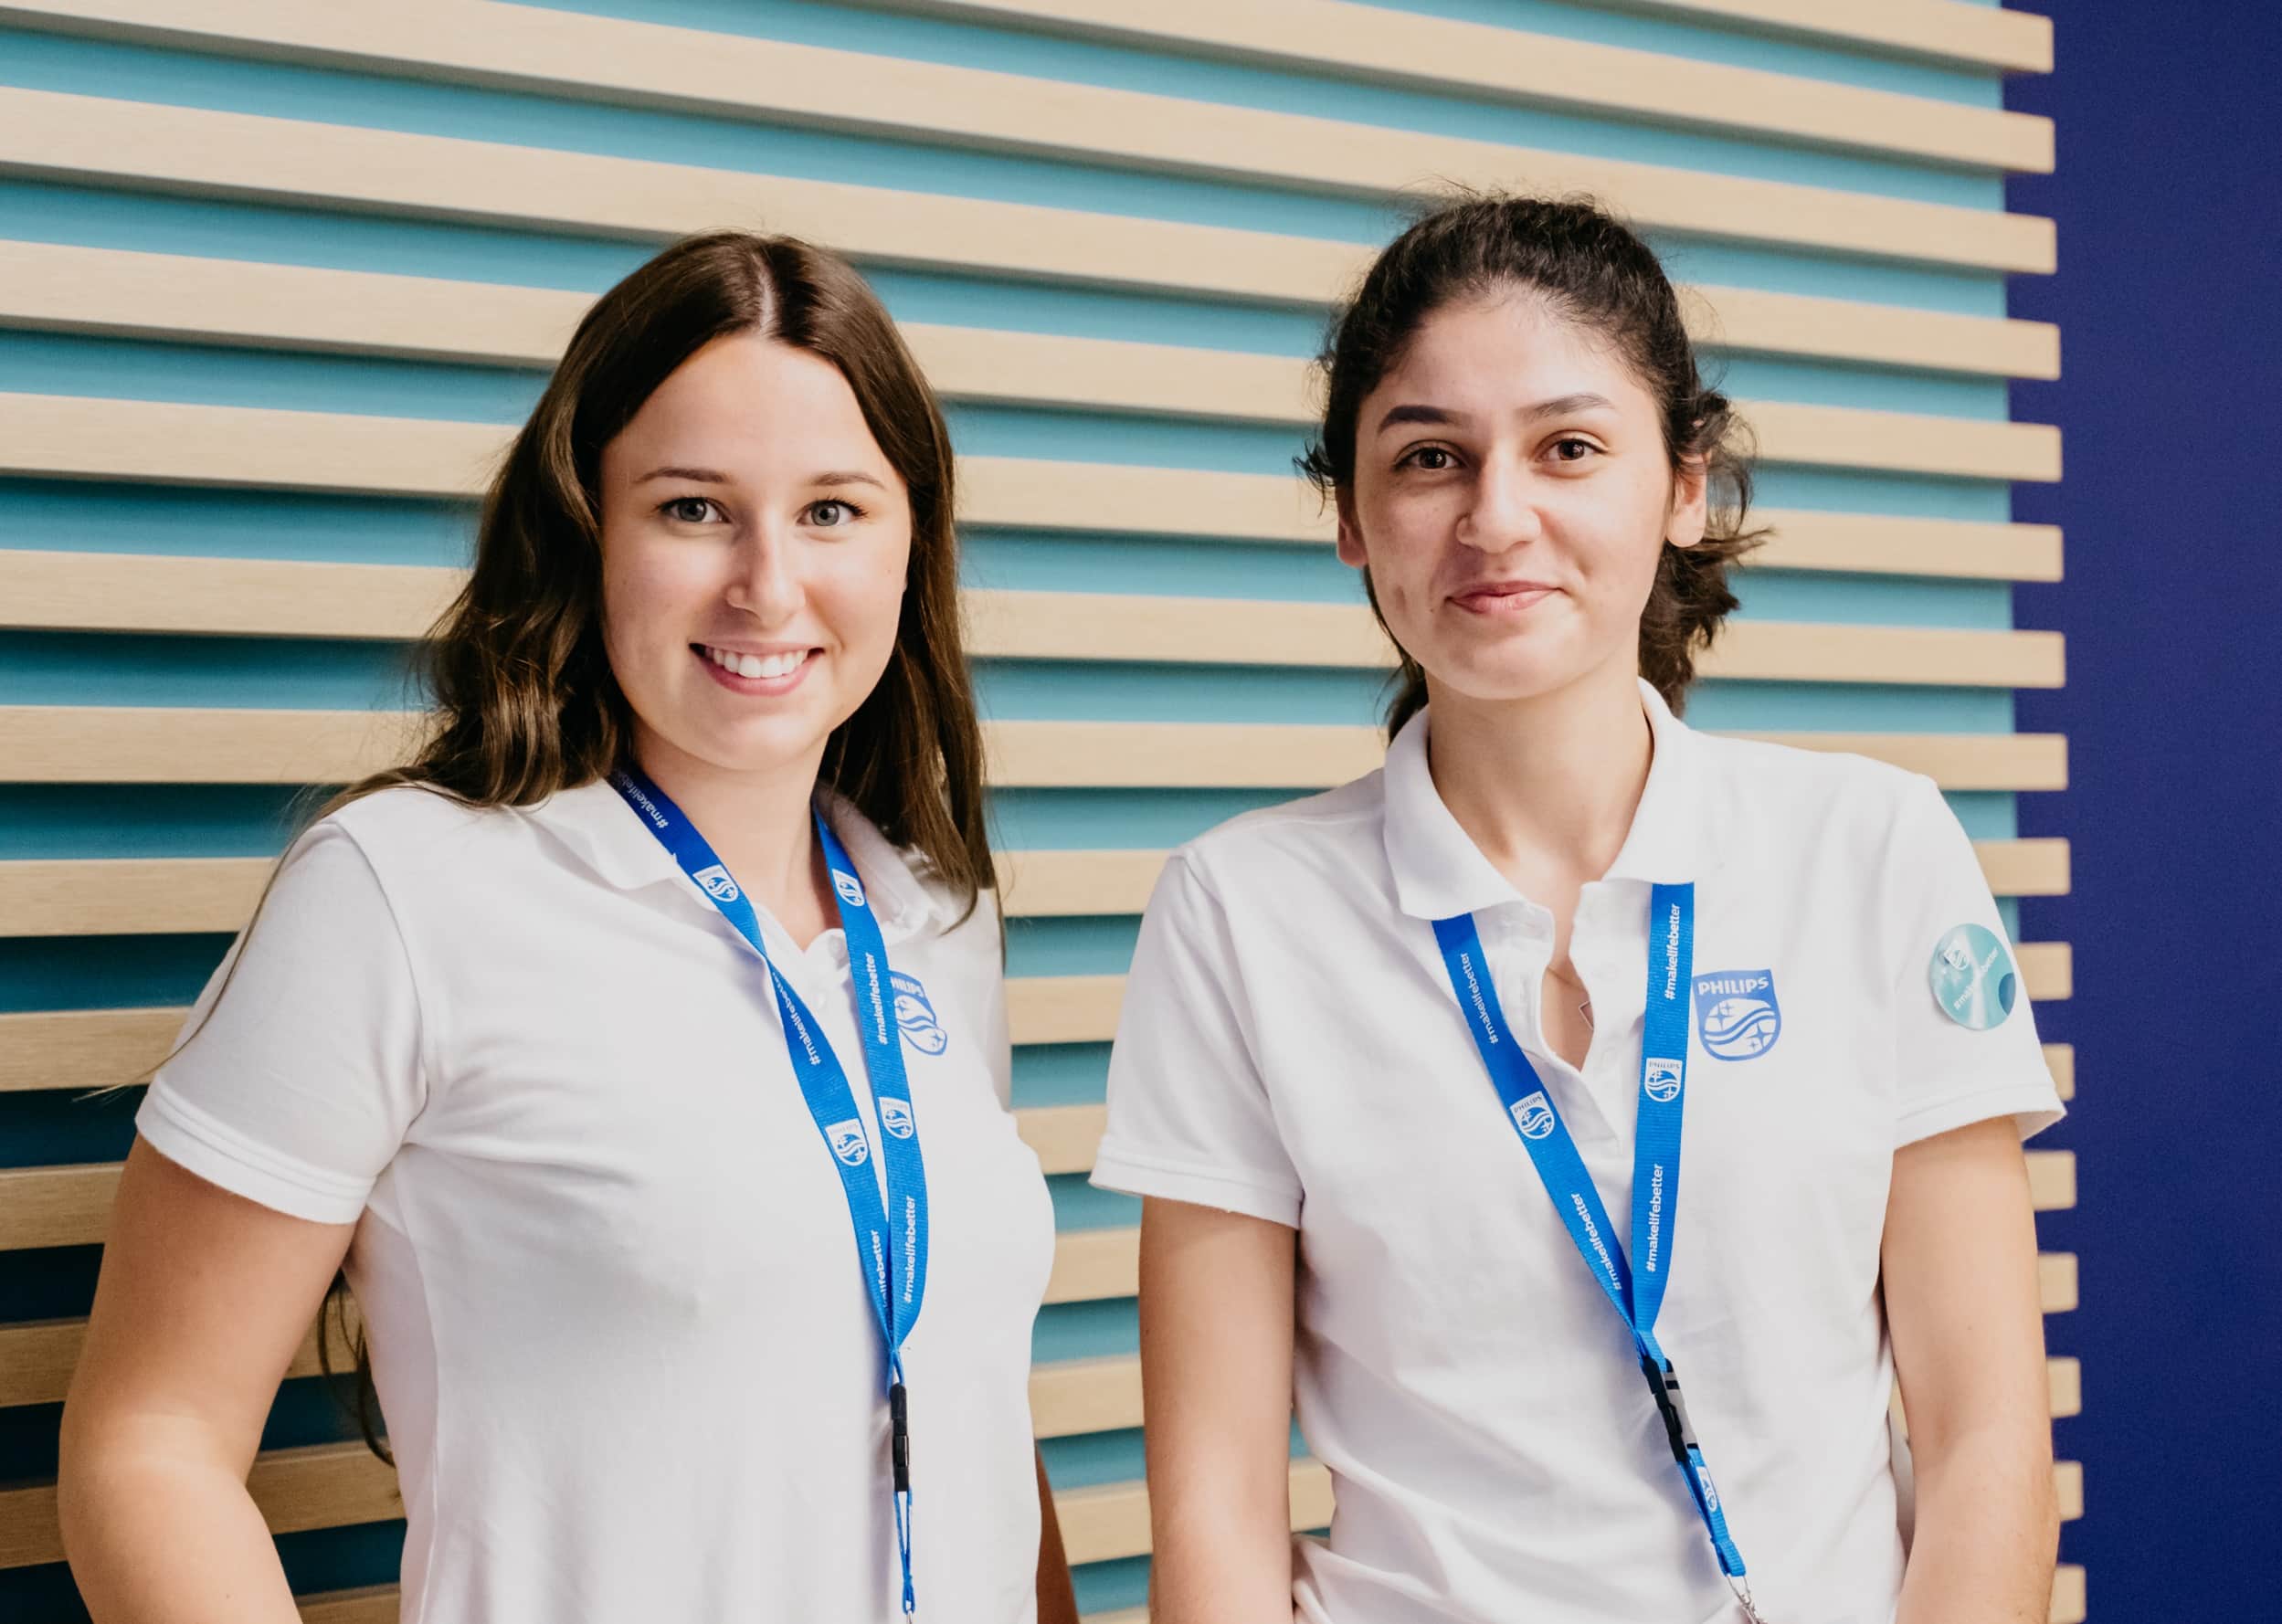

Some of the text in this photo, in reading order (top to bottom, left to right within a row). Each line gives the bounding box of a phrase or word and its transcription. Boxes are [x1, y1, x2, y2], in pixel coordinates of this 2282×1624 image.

[865, 952, 888, 1045] #makelifebetter
[1461, 953, 1499, 1044] #makelifebetter
[1664, 902, 1681, 1000] #makelifebetter
[1697, 976, 1770, 996] PHILIPS
[1513, 1095, 1543, 1113] PHILIPS
[903, 1195, 915, 1303] #makelifebetter
[1570, 1192, 1622, 1291] #makelifebetter
[1646, 1164, 1664, 1272] #makelifebetter
